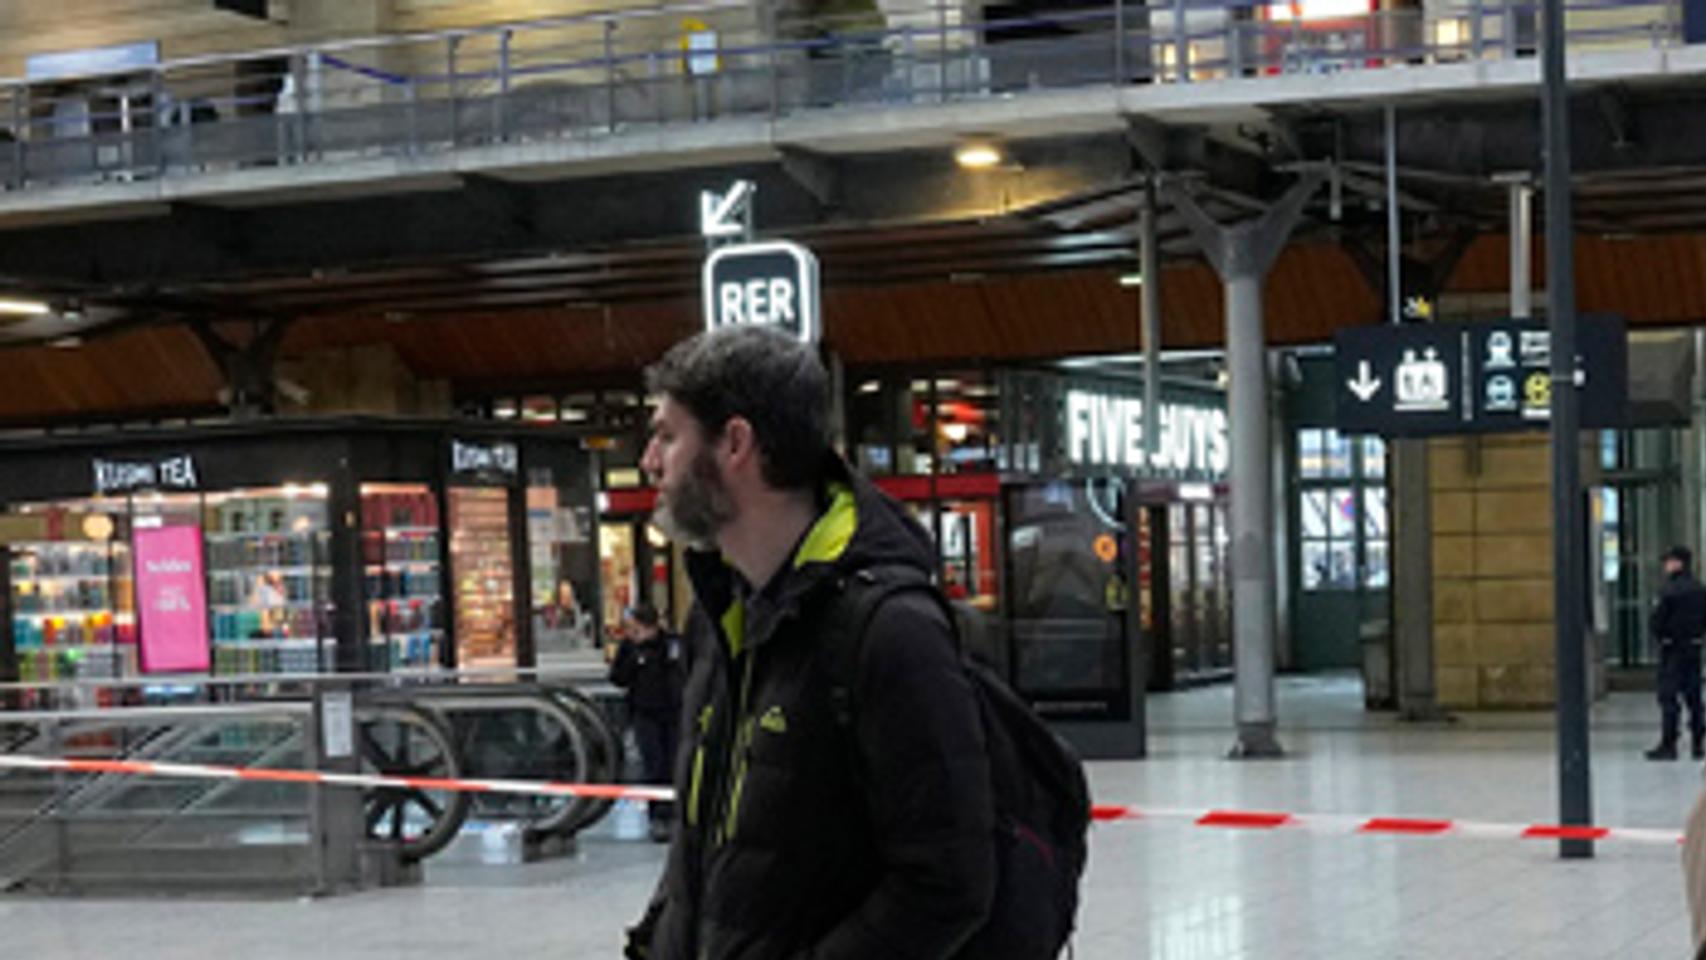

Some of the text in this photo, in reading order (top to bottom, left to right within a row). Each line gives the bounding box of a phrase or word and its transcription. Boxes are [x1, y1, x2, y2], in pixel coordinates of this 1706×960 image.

[721, 277, 796, 324] RER
[1066, 389, 1229, 473] FIVE GUYS
[92, 455, 197, 490] KUSMI TEA
